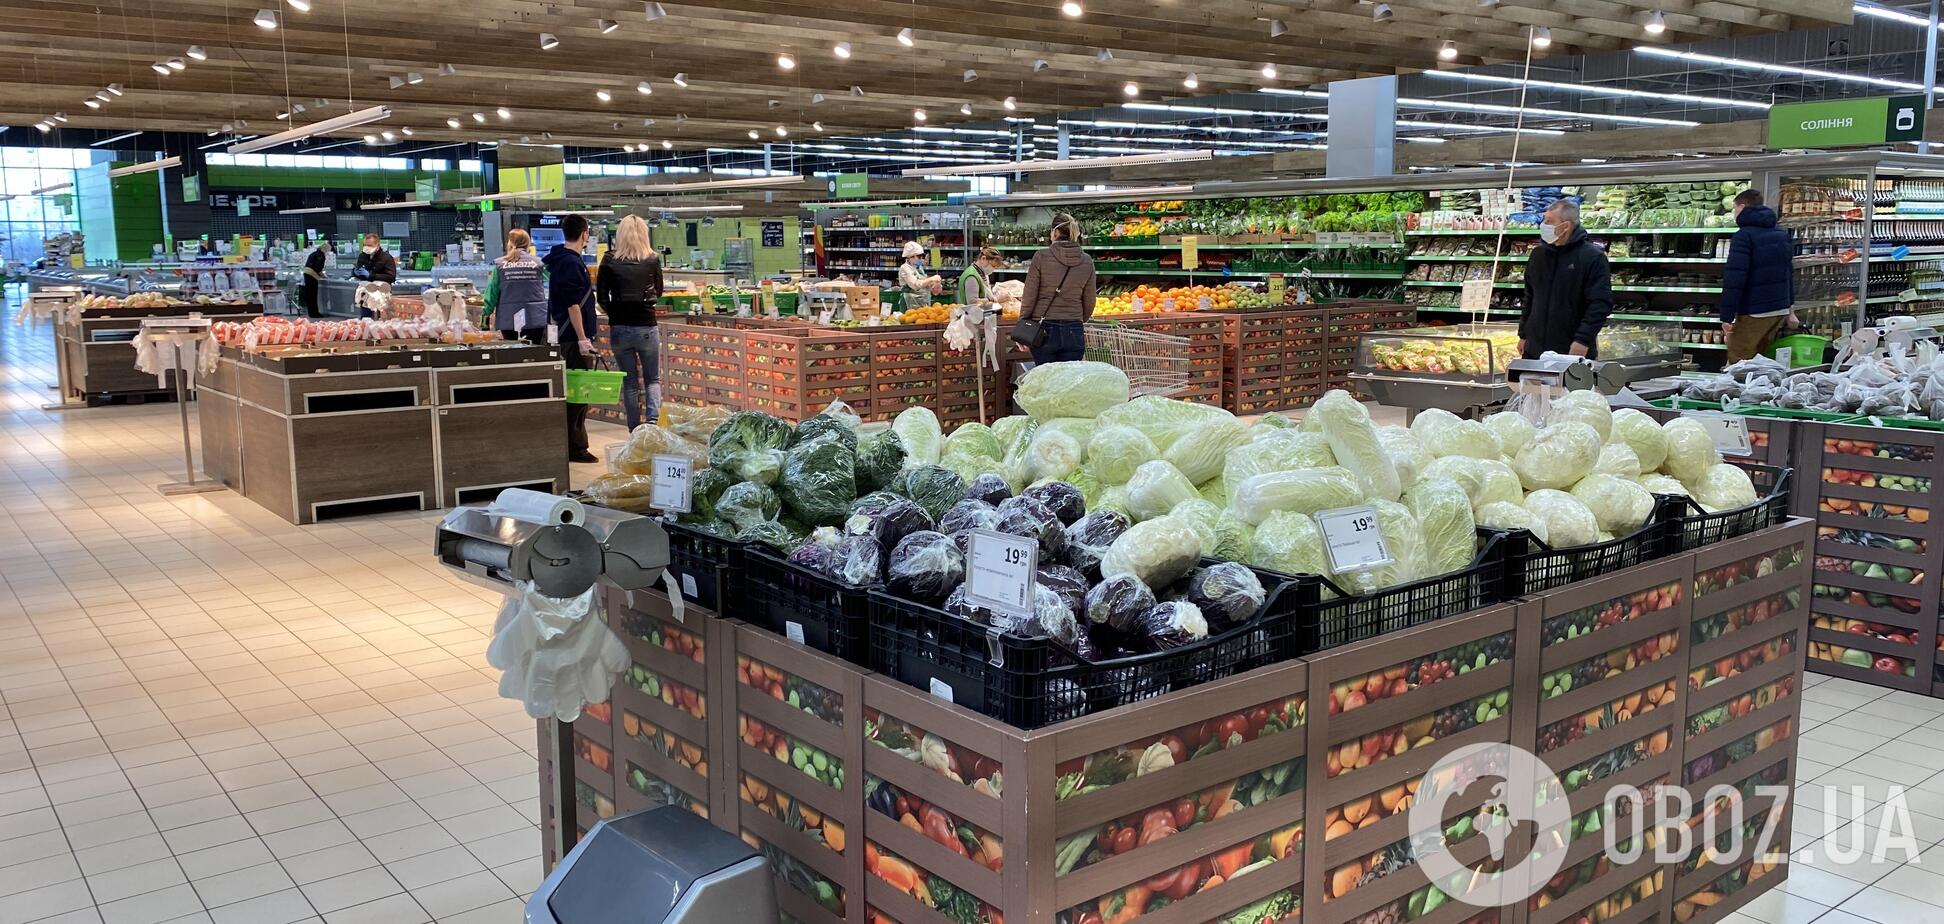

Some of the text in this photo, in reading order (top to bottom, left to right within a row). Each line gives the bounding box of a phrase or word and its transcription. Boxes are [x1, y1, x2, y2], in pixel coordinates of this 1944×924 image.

[1800, 117, 1853, 130] СОЛІННЯ
[1723, 420, 1730, 428] 7
[1352, 518, 1368, 532] 19
[1004, 547, 1020, 564] 19
